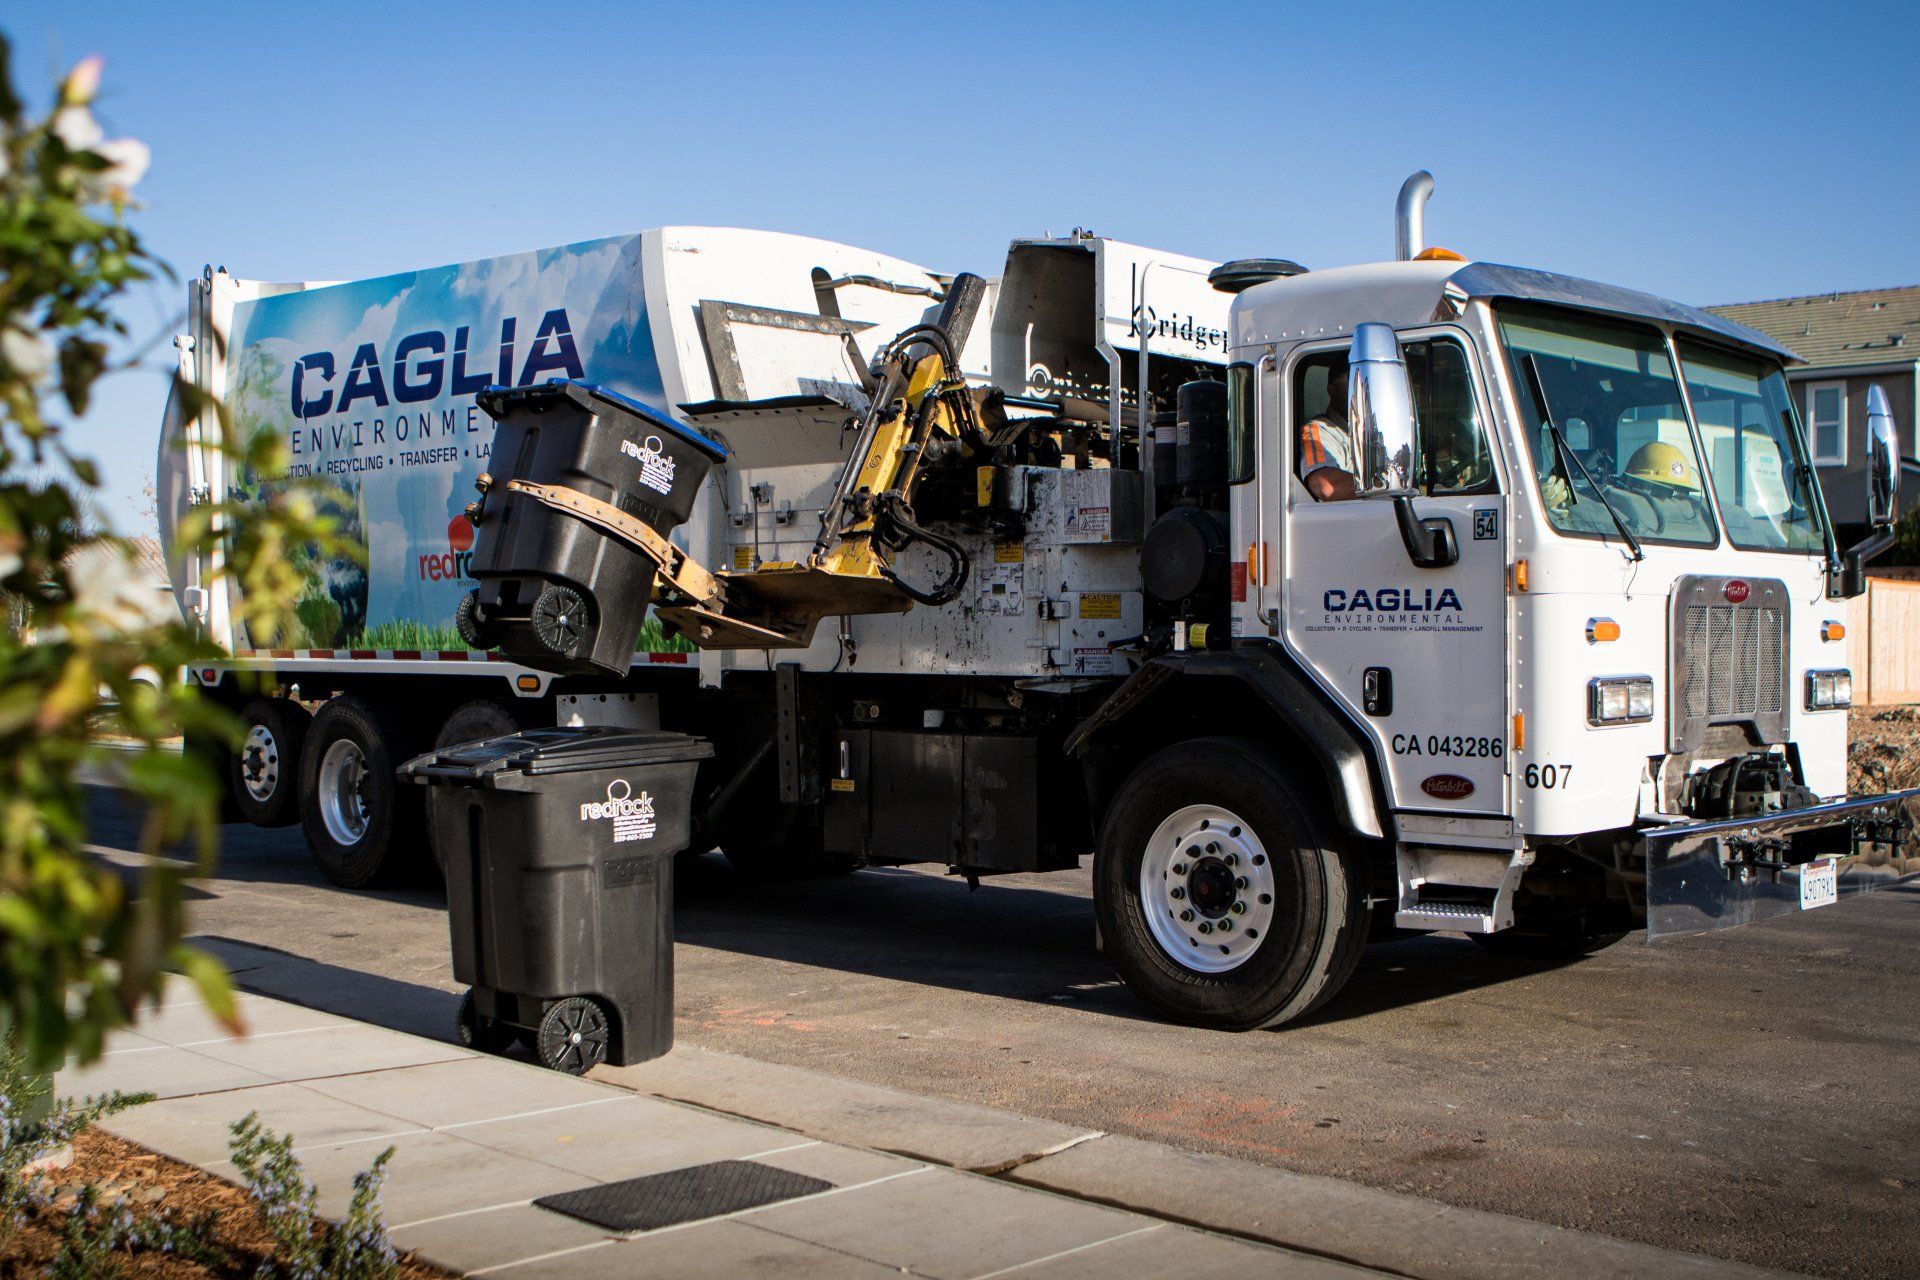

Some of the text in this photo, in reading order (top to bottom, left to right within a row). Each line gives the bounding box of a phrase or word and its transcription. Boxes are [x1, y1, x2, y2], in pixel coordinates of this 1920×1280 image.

[291, 308, 585, 424] CAGLIA
[292, 406, 496, 454] ENVIRONME
[327, 455, 384, 474] RECYCLING
[400, 446, 458, 467] TRANSFER
[476, 442, 493, 459] LA
[621, 436, 675, 478] redrock
[1477, 518, 1495, 537] 54
[1323, 588, 1463, 612] CAGLIA
[1324, 614, 1463, 624] ENVIRONMENTAL
[1392, 734, 1503, 758] CA 043286
[1426, 779, 1470, 793] Peterbilt
[1524, 763, 1573, 789] 607
[581, 782, 655, 820] redrock
